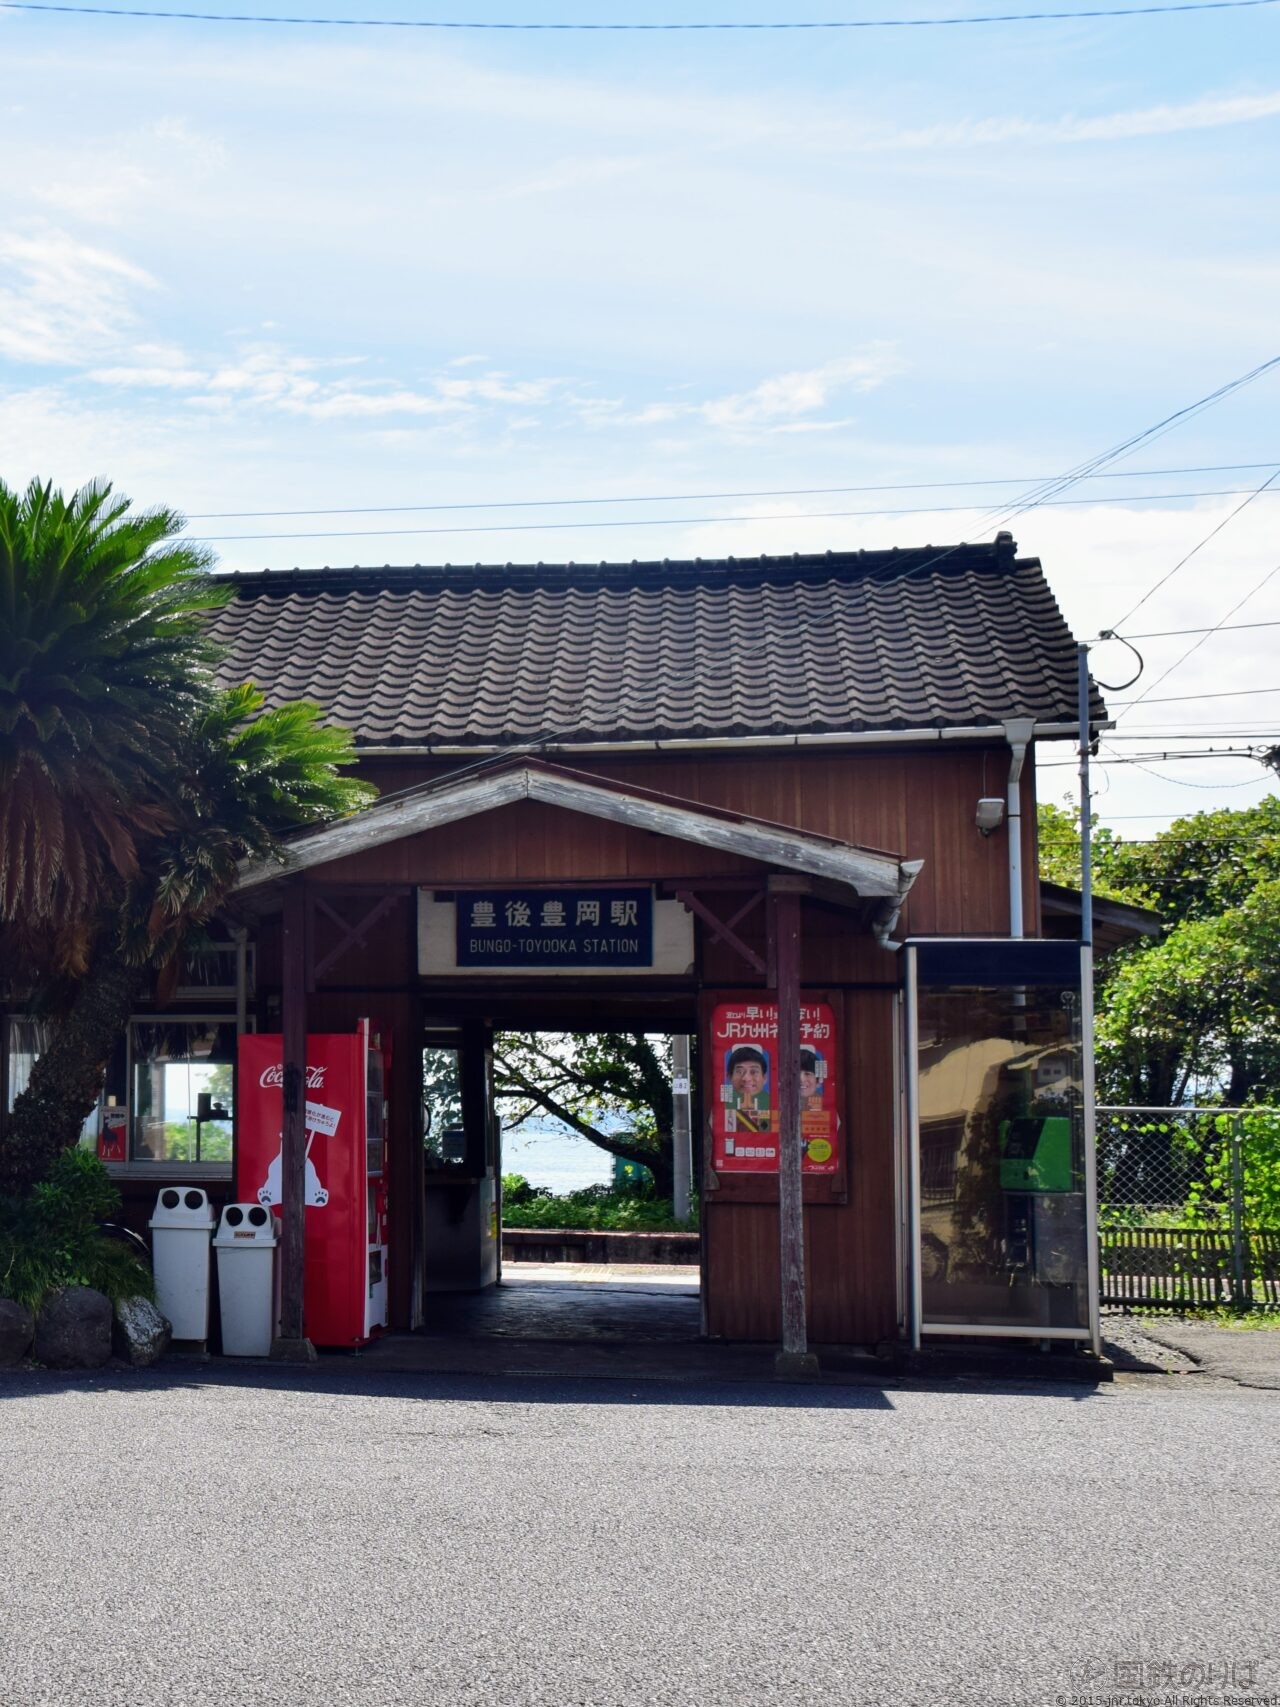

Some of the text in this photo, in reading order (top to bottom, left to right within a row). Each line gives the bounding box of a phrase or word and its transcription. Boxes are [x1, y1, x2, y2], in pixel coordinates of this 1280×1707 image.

[470, 900, 637, 927] 豊後豊岡駅
[469, 939, 639, 953] BUNGO-TOYOOKA STATION
[716, 1022, 830, 1039] JR九州ネ予約
[259, 1066, 329, 1088] Cocla
